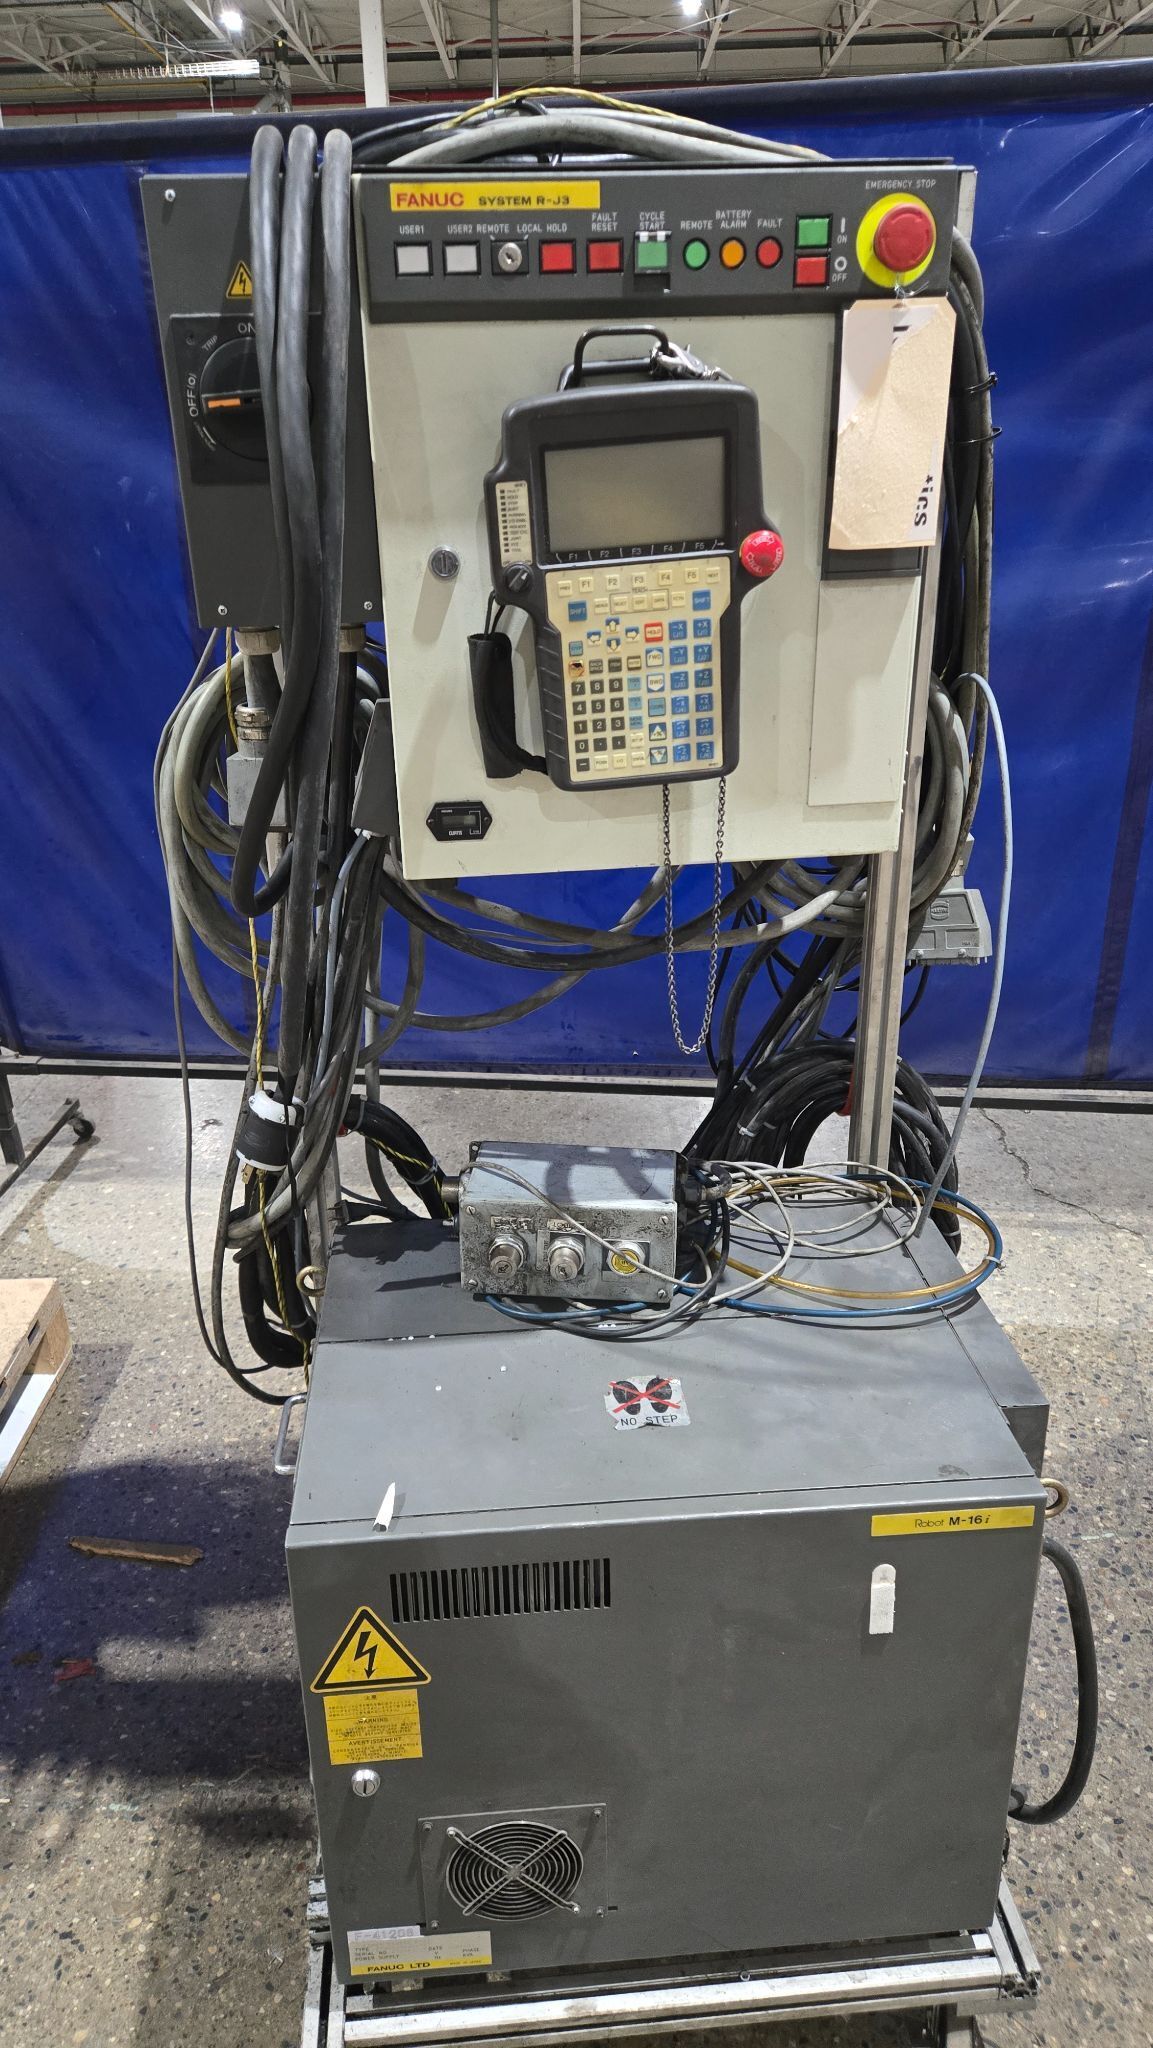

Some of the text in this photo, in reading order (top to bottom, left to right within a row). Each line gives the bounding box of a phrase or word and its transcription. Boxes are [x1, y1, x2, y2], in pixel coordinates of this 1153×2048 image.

[865, 179, 936, 190] EMERGENCY STOP
[396, 192, 570, 208] FANUC SYSTEM R-J3
[591, 212, 618, 222] FAULT
[639, 211, 665, 221] CYCLE
[716, 210, 751, 220] BATTERY
[447, 224, 473, 234] USER2
[476, 223, 542, 233] REMOTE LOCAL
[546, 223, 568, 233] HOLD
[591, 222, 618, 232] RESET
[639, 221, 665, 230] START
[680, 220, 713, 230] REMOTE
[720, 219, 747, 229] ALARM
[757, 219, 784, 229] FAULT
[400, 225, 424, 234] USER1
[837, 234, 848, 244] ON
[831, 272, 848, 283] OFF
[202, 335, 218, 351] TRIP
[695, 542, 704, 550] F5
[582, 580, 590, 588] F1
[608, 578, 618, 586] F2
[634, 576, 644, 584] F3
[570, 608, 586, 616] SHIFT
[576, 684, 581, 692] 7
[594, 682, 600, 690] 8
[613, 680, 620, 688] 9
[596, 702, 602, 710] 5
[614, 700, 620, 708] 6
[580, 742, 585, 750] 0
[620, 1414, 678, 1426] NO STEP
[914, 1518, 945, 1528] Robot
[349, 1737, 402, 1746] AVERTISSEMENT
[368, 1964, 404, 1972] FANUC
